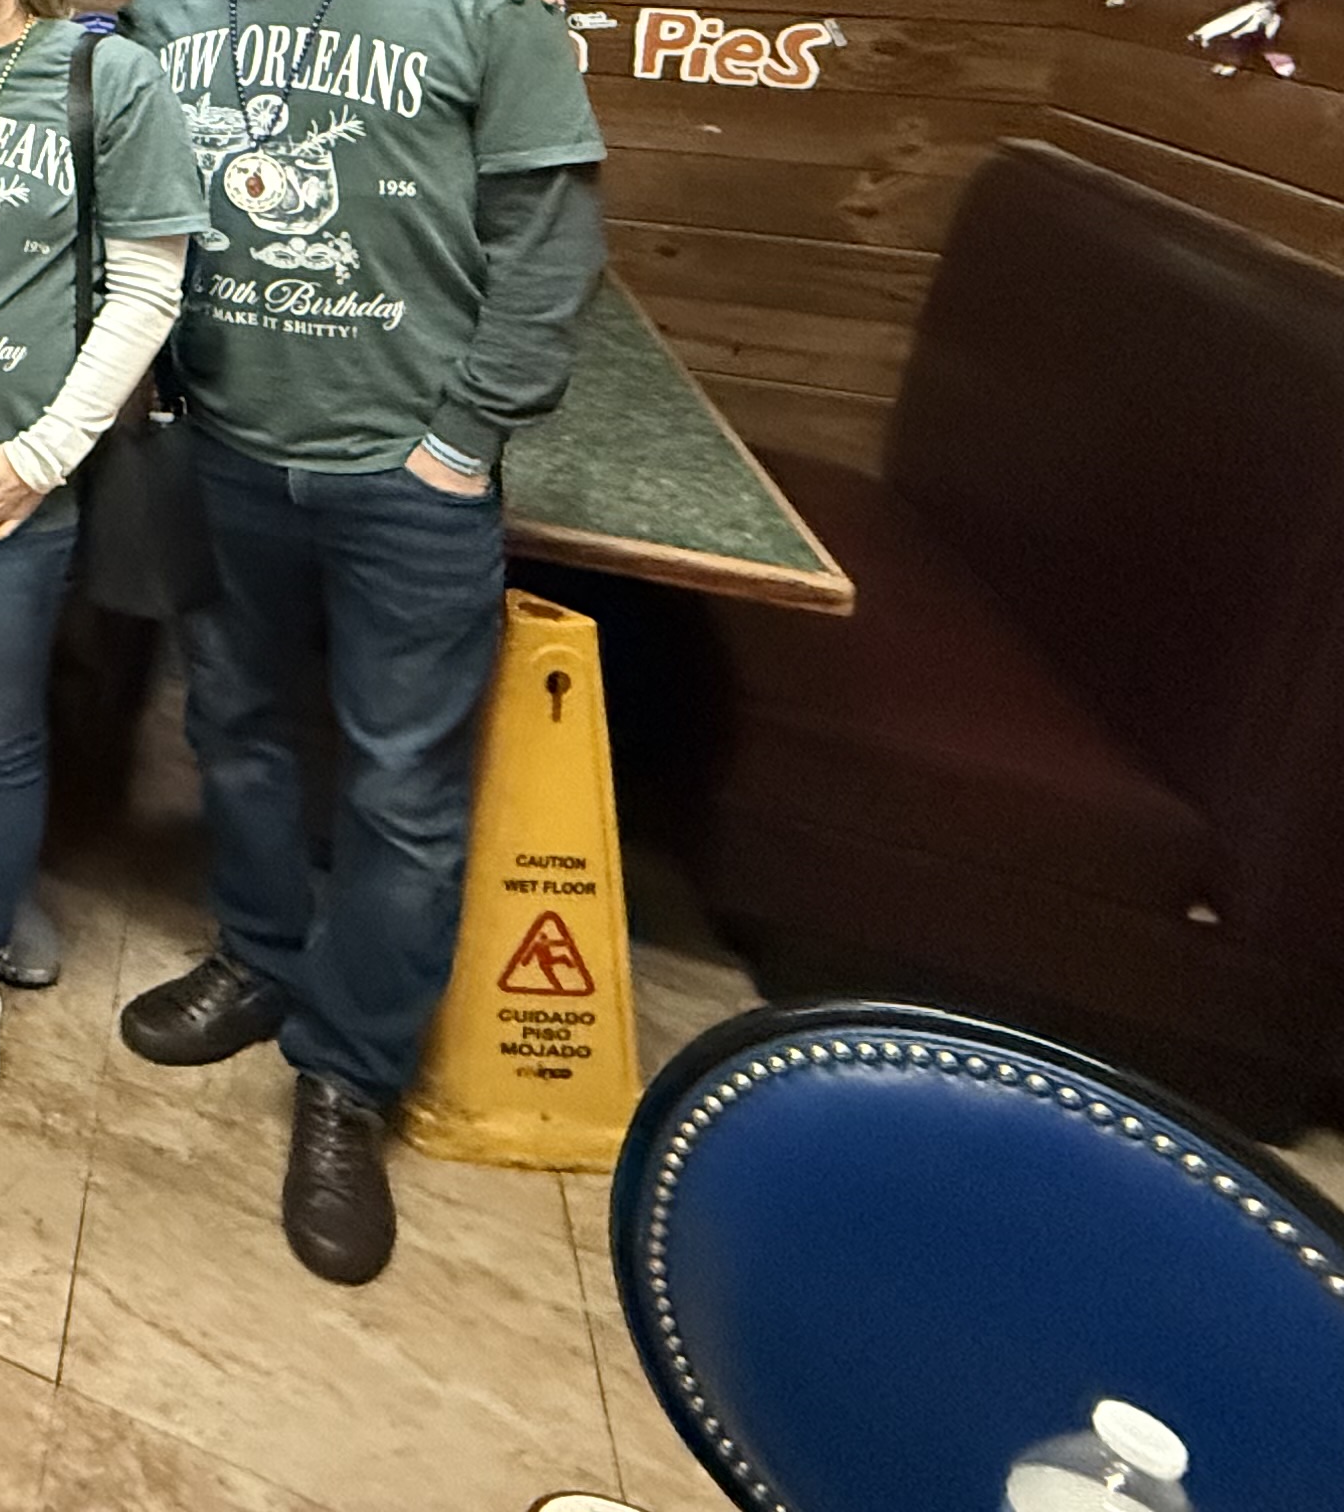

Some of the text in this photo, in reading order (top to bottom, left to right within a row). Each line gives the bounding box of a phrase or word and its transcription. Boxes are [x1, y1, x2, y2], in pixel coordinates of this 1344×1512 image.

[633, 7, 833, 90] Pies
[233, 23, 429, 119] ORLEANS
[378, 179, 418, 198] 1956
[208, 273, 407, 332] 70th Birthday
[212, 306, 359, 339] MAKE IT SHITTY!
[515, 854, 587, 870] CAUTION
[502, 879, 597, 896] WET FLOOR
[498, 1008, 596, 1026] CUIDADO
[521, 1027, 571, 1042] PISO
[499, 1042, 592, 1059] MOJADO
